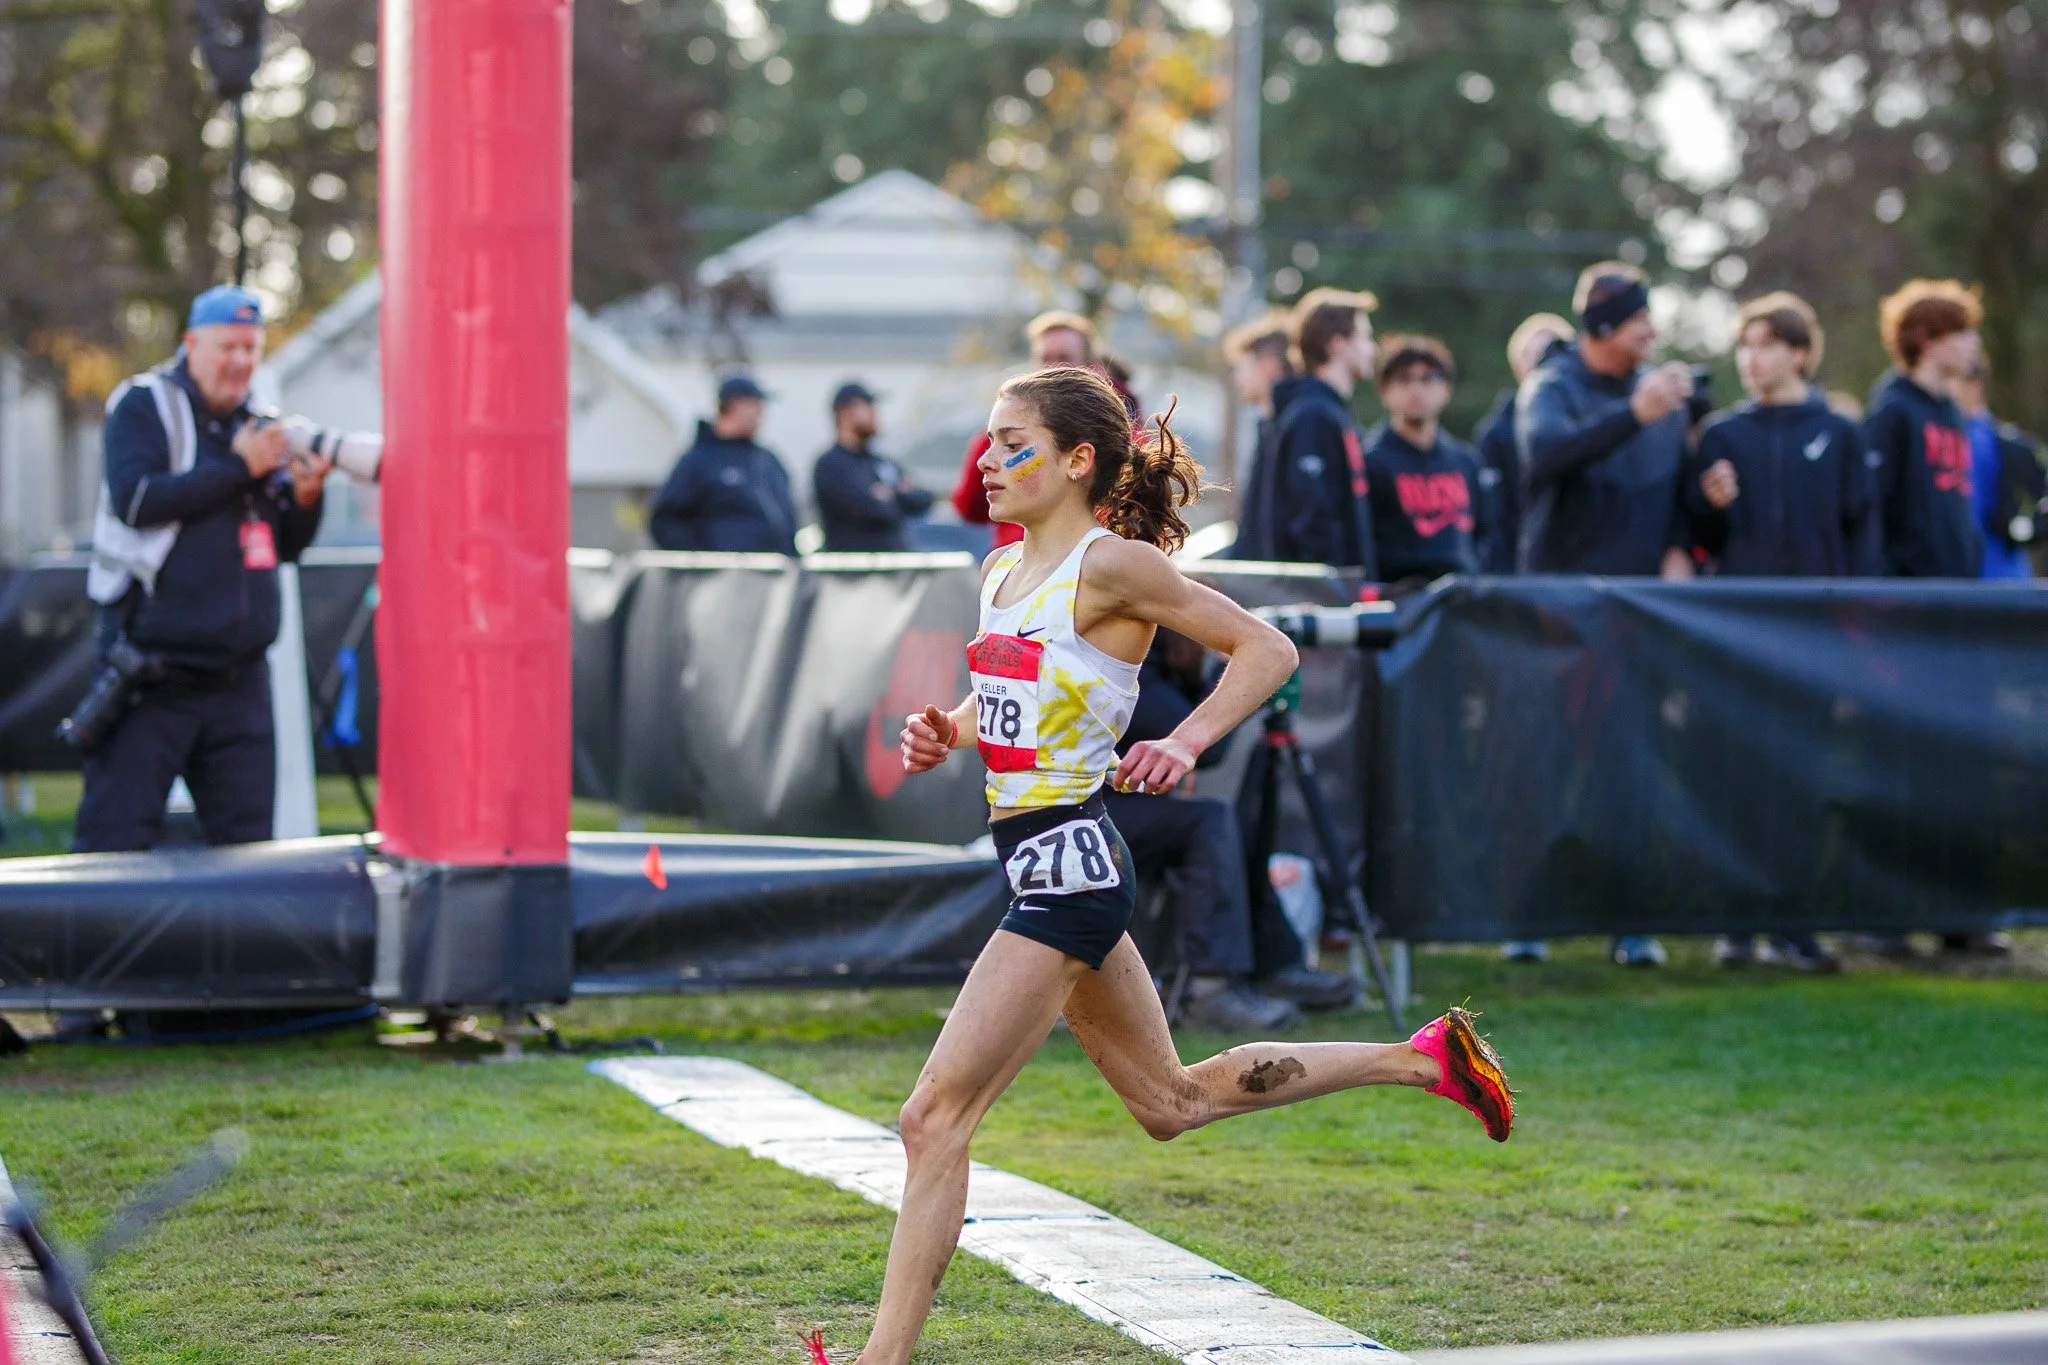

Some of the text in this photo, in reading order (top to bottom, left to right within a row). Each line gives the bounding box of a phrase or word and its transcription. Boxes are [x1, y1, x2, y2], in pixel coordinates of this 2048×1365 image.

[991, 639, 1025, 654] CROSS
[981, 683, 1007, 695] KELLER
[978, 694, 1021, 739] 278
[1014, 826, 1110, 892] 278
